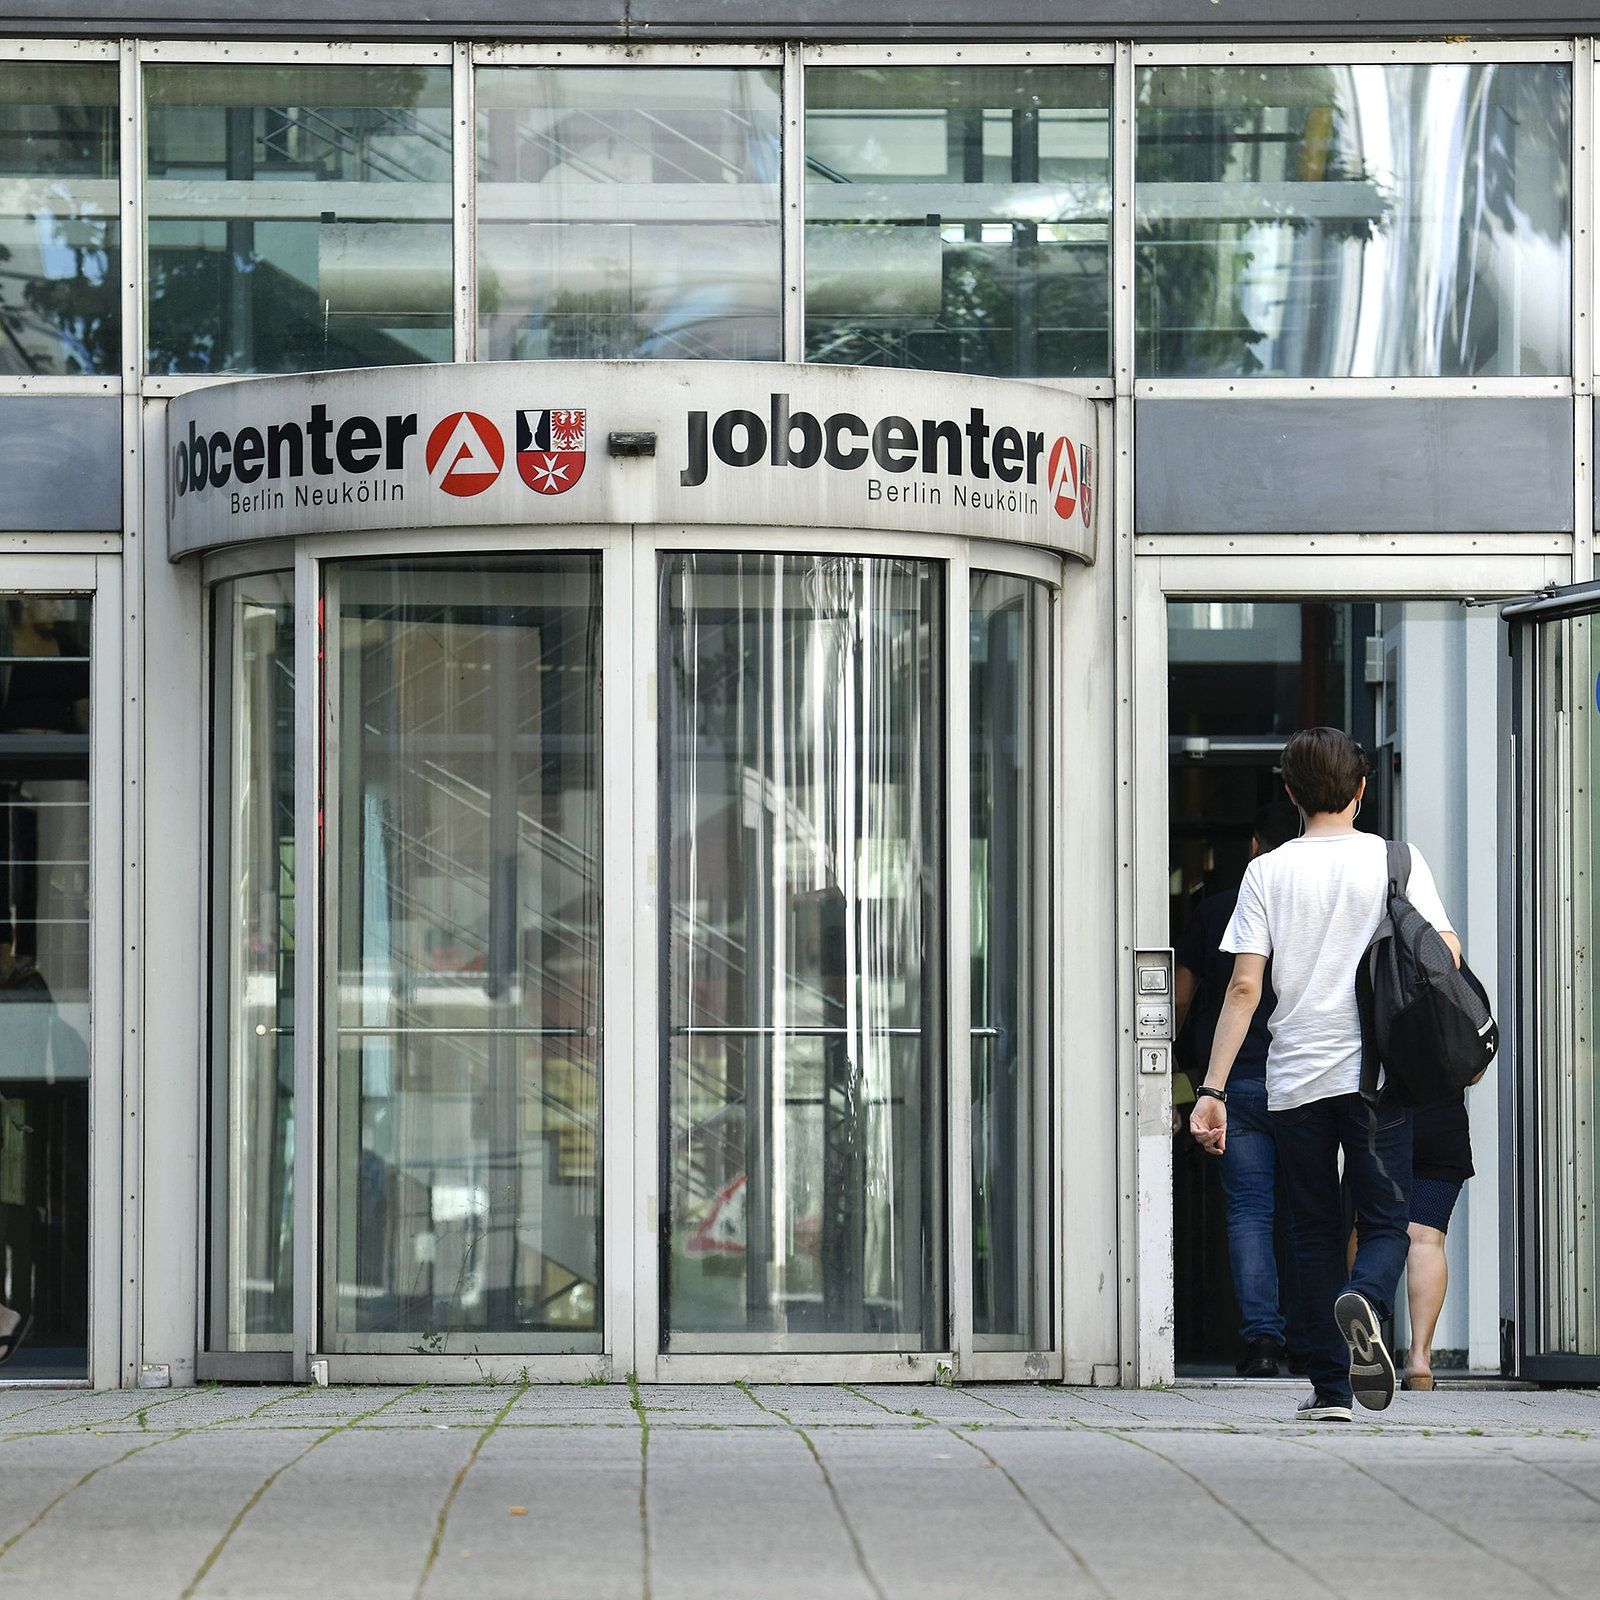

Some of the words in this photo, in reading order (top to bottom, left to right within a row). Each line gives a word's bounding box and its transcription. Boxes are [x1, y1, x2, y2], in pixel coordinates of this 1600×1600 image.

[680, 393, 1044, 487] jobcenter
[230, 490, 284, 515] Berlin
[295, 479, 404, 508] Neukölln
[867, 478, 941, 505] Berlin
[953, 483, 1038, 515] Neukölln
